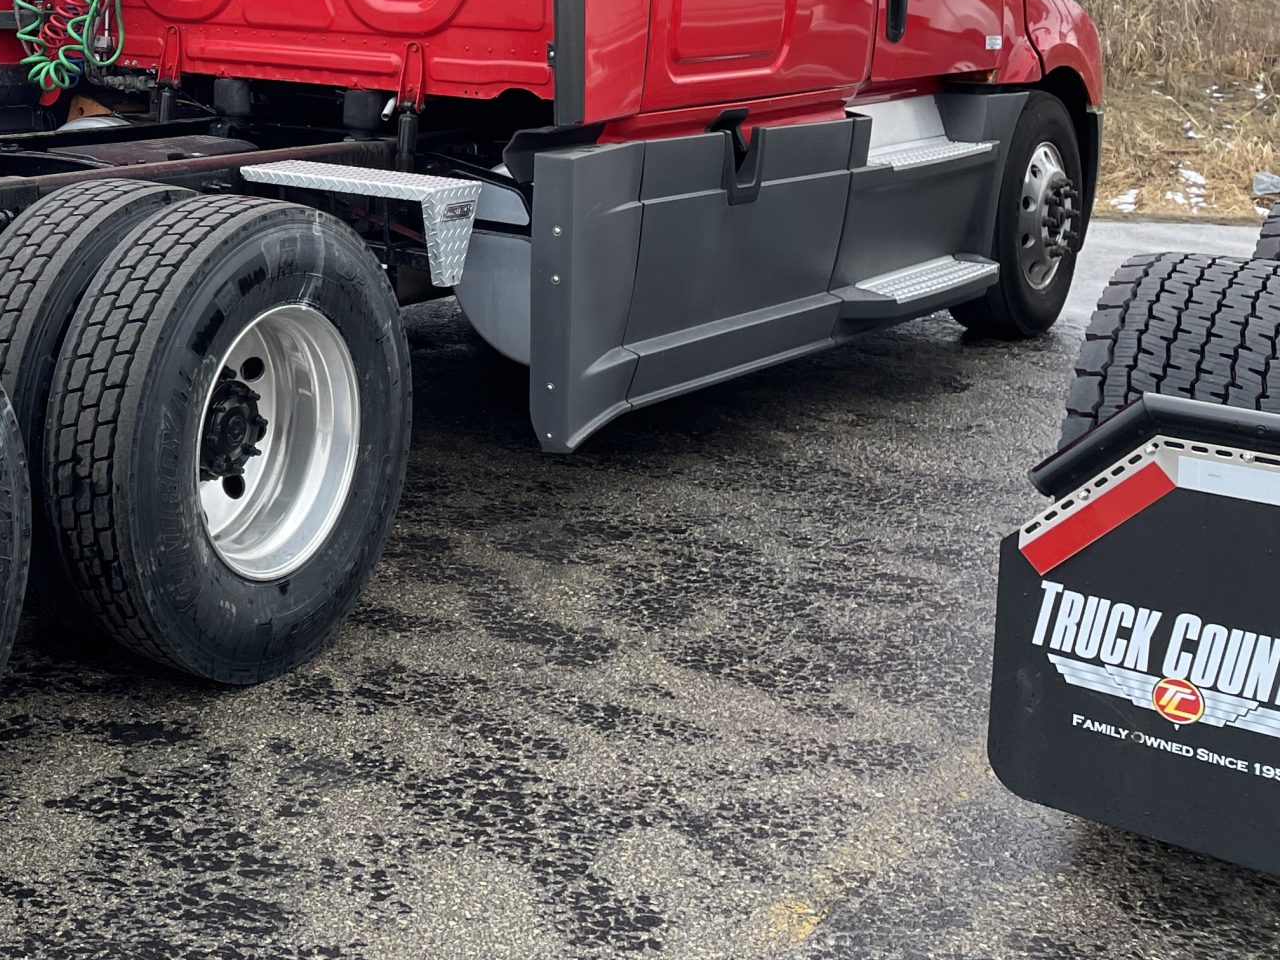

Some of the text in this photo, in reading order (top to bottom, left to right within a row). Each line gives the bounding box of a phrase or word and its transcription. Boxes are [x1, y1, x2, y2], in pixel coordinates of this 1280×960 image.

[1031, 580, 1163, 673] TRUCK
[1072, 713, 1129, 741] FAMILY
[1130, 730, 1194, 758] OWNED
[1195, 747, 1249, 773] SINCE
